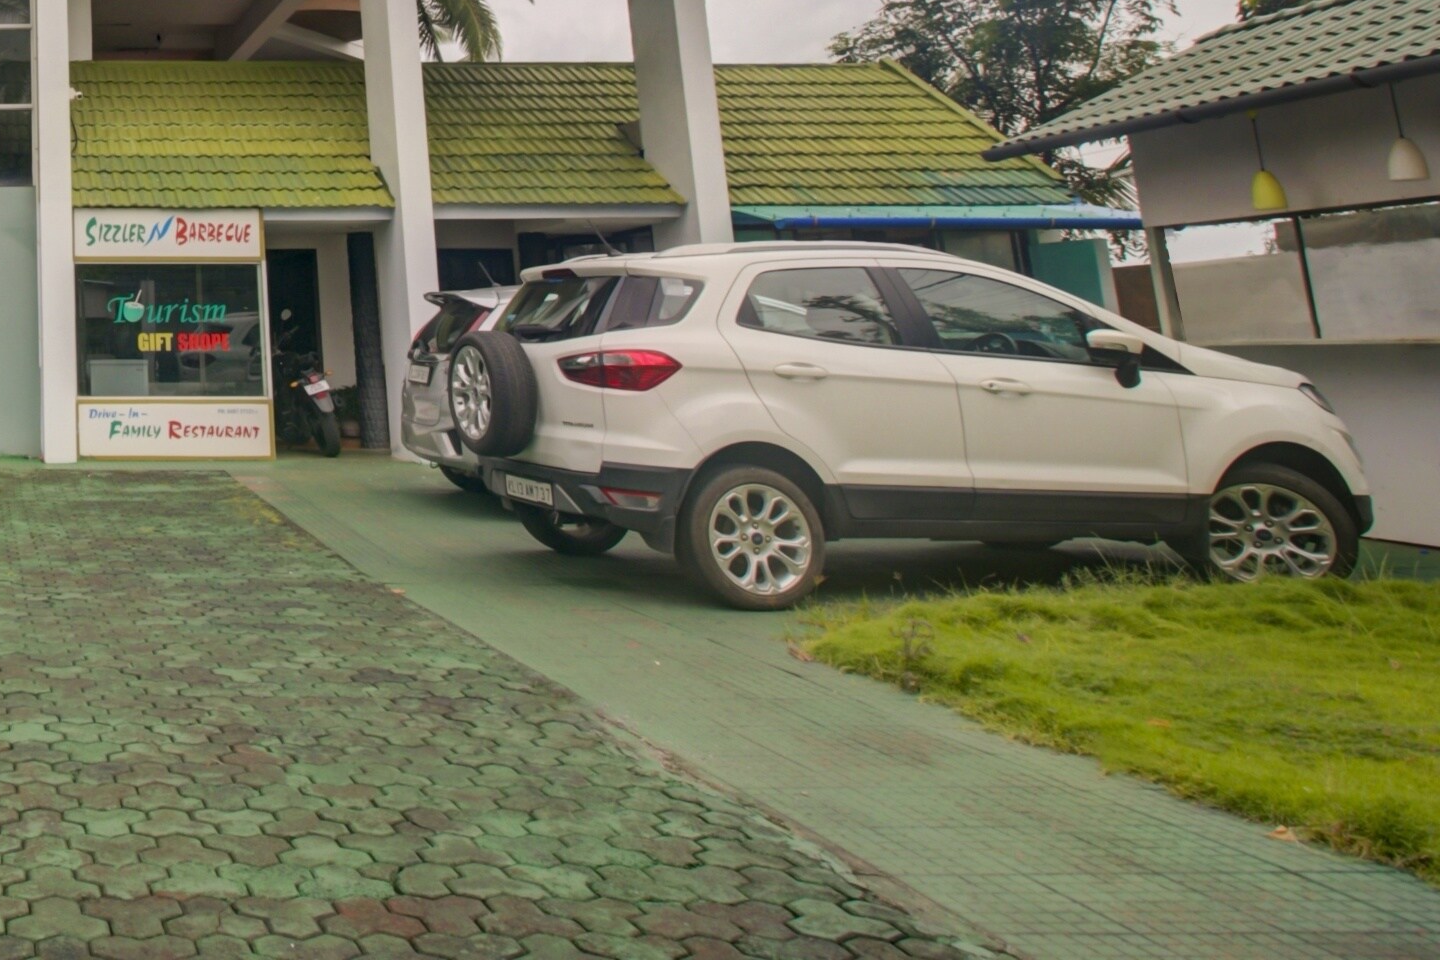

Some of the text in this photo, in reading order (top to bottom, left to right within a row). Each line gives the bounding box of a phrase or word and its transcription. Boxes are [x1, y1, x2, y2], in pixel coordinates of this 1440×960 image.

[86, 216, 146, 246] SIZZLER
[137, 332, 174, 352] GIFT
[109, 420, 260, 440] FAMILY RESTAURANT
